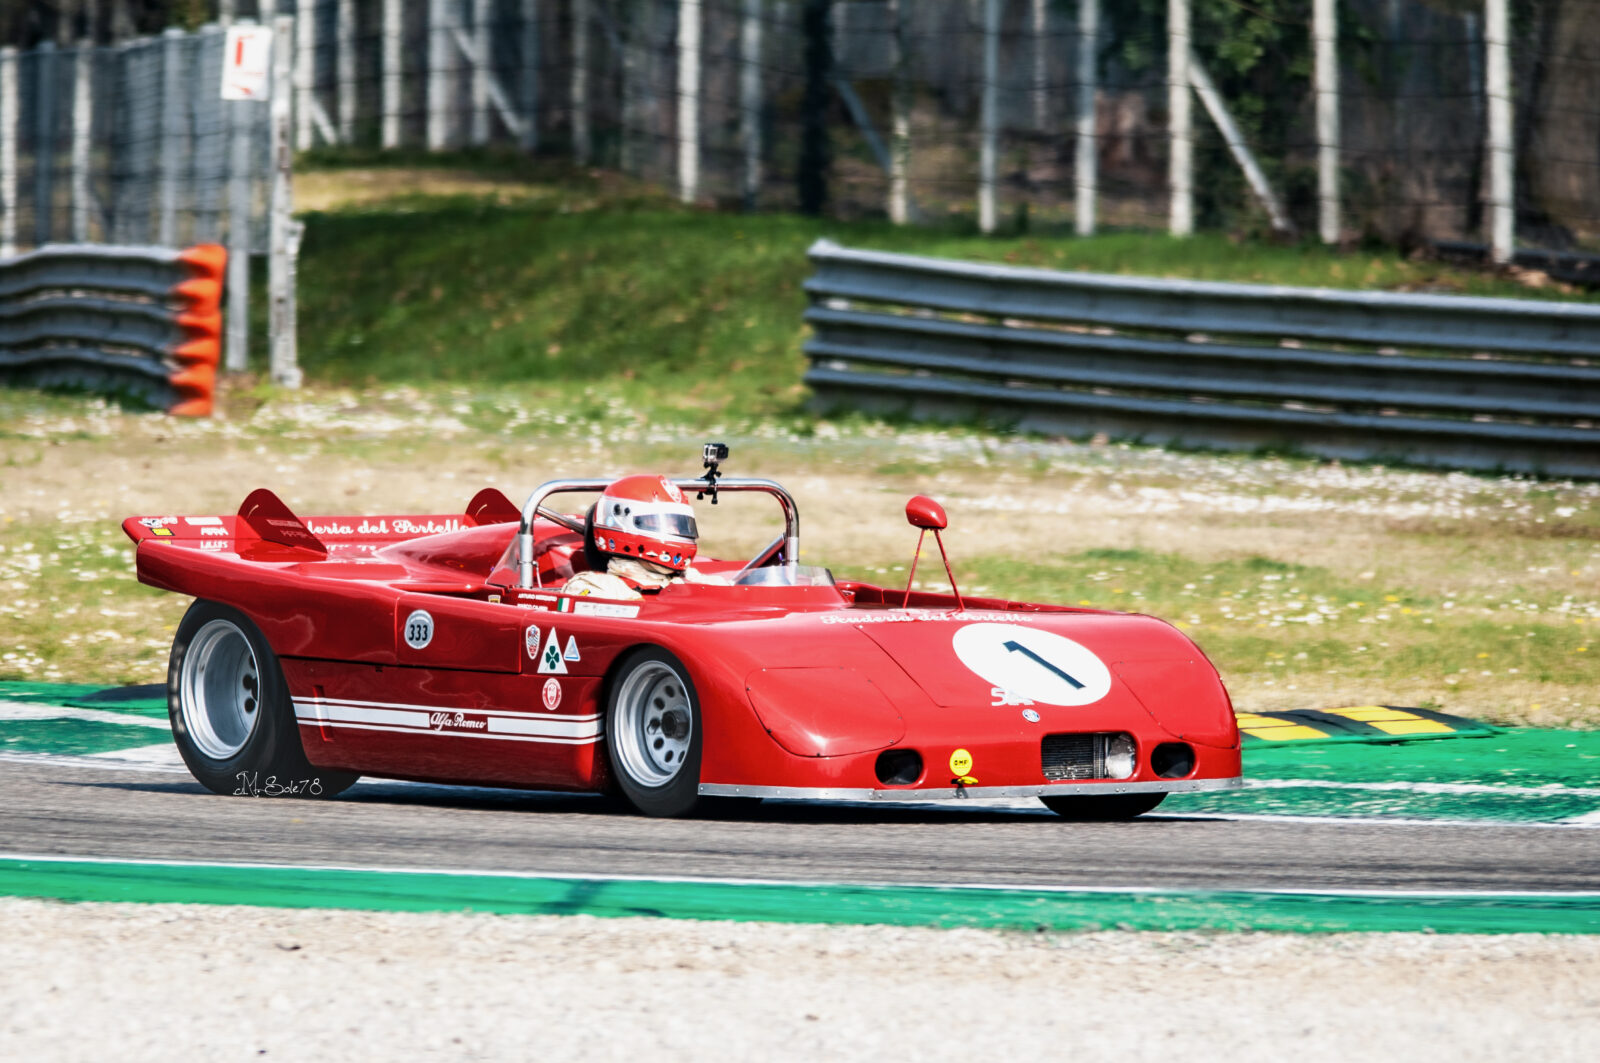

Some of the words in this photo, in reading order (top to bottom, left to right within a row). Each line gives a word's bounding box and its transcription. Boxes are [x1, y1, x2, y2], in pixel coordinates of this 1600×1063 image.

[357, 520, 389, 534] del
[820, 614, 914, 624] Scuderia
[918, 612, 951, 621] del
[408, 623, 428, 641] 333
[1002, 640, 1087, 690] 1
[430, 712, 453, 731] Alfa
[454, 712, 487, 729] Romeo
